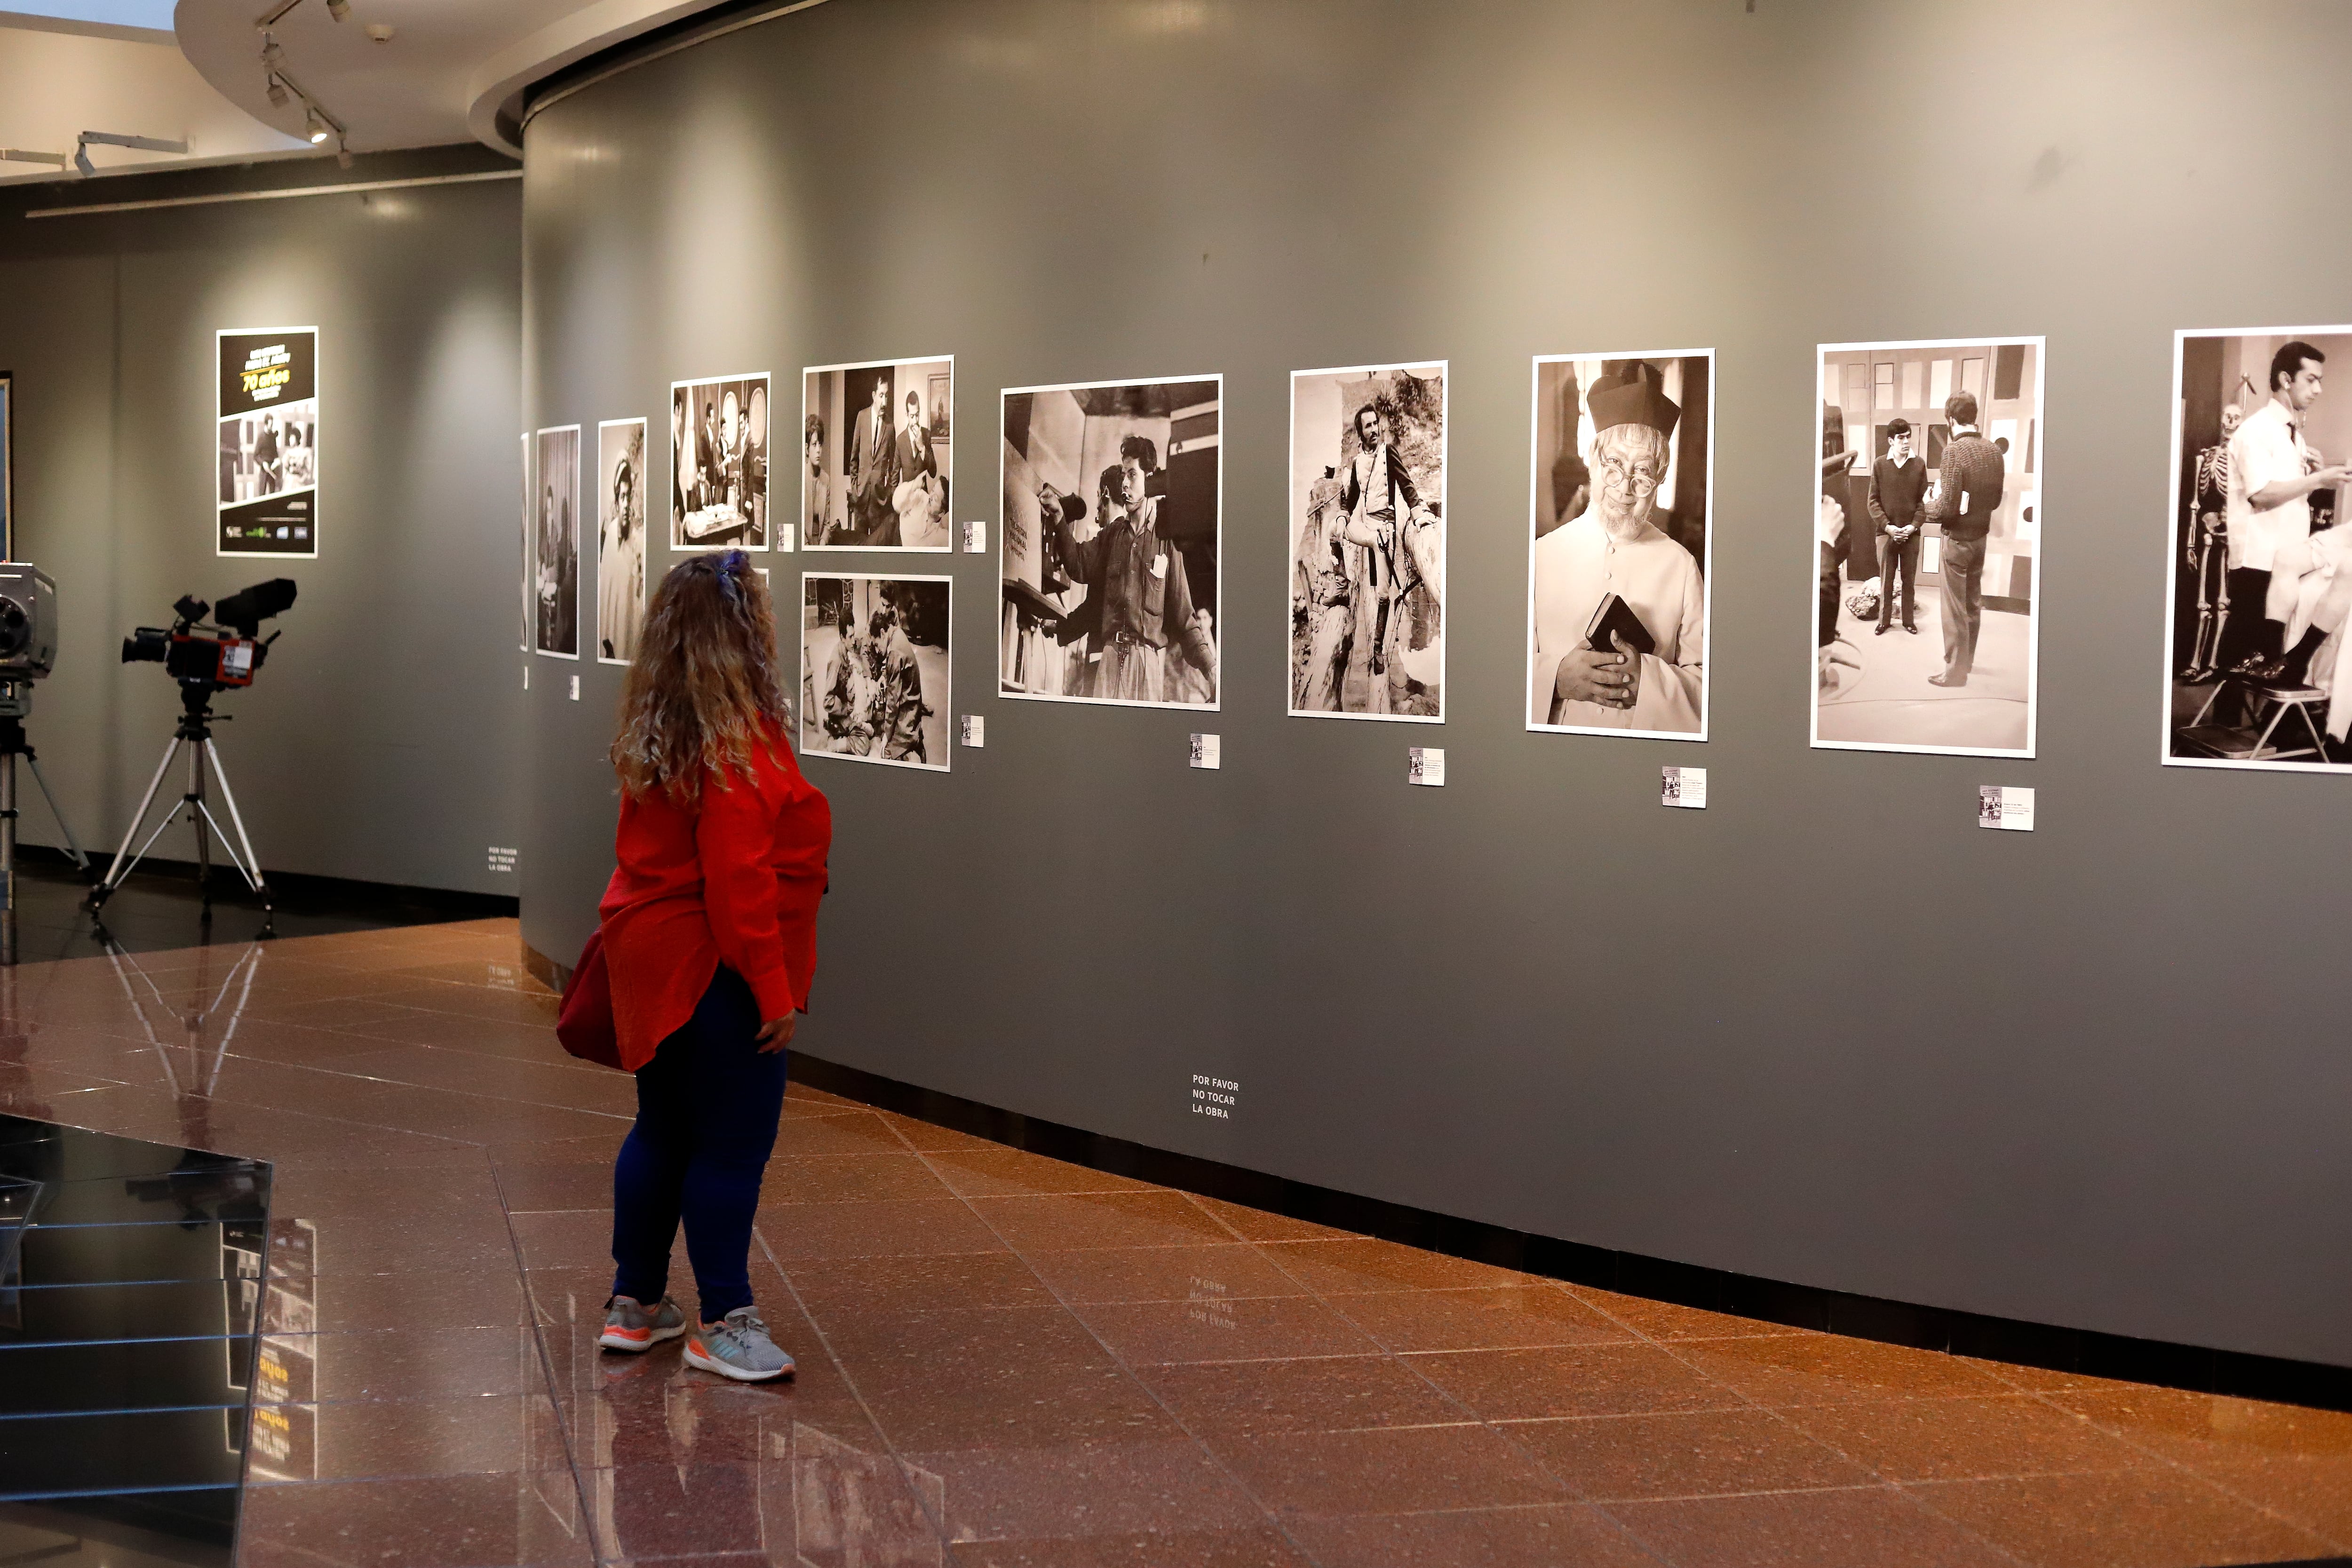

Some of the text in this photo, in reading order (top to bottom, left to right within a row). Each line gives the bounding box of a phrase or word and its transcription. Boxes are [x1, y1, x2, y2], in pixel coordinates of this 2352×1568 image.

[243, 374, 258, 392] 70
[259, 368, 290, 389] años
[1193, 1075, 1239, 1091] POR FAVOR
[1192, 1089, 1235, 1106] NO TOCAR
[1192, 1104, 1229, 1119] LA OBRA
